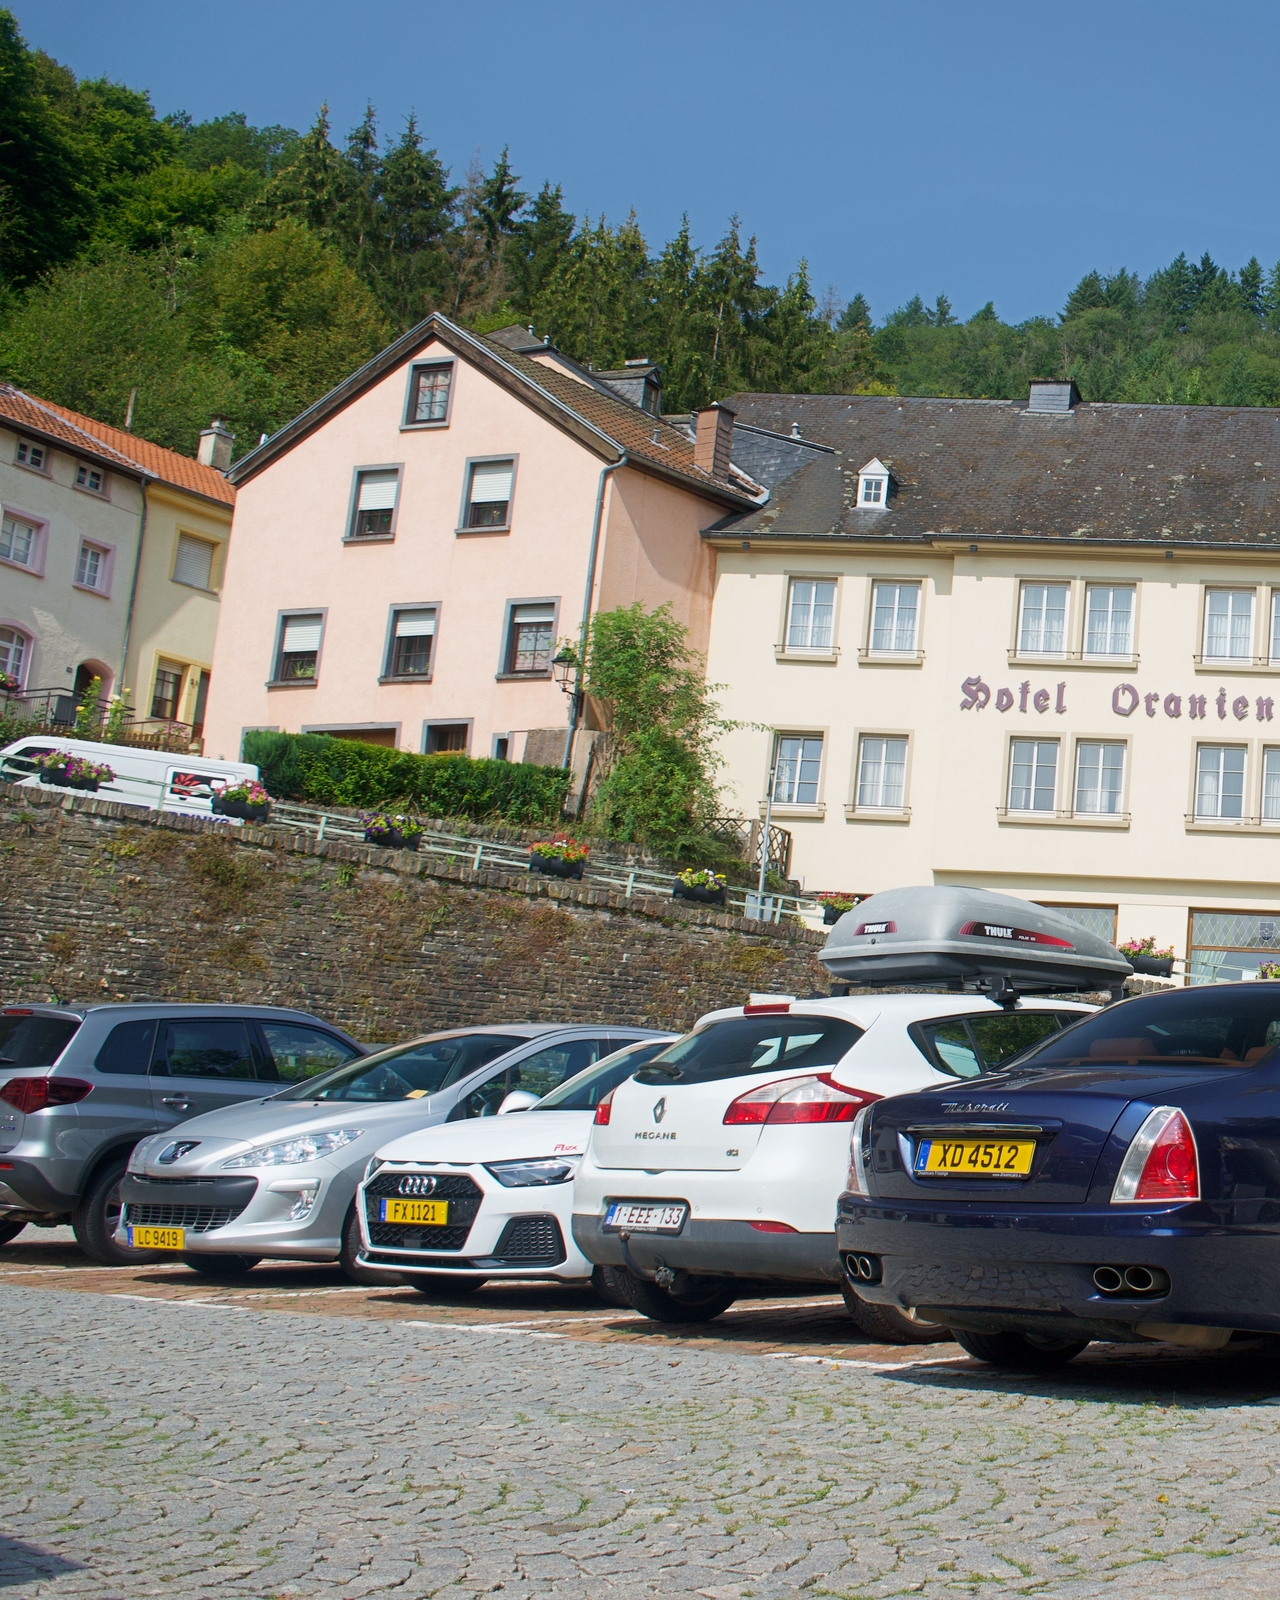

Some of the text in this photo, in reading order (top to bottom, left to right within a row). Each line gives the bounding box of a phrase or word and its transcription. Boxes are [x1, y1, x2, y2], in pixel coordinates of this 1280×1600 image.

[960, 675, 1067, 713] Hotel
[864, 923, 887, 933] THULE
[984, 925, 1013, 938] THULE
[938, 1144, 964, 1167] XD
[968, 1144, 1019, 1169] 4512
[394, 1203, 408, 1219] FX
[411, 1203, 436, 1221] 1121
[138, 1229, 151, 1245] LC
[153, 1230, 178, 1246] 9419
